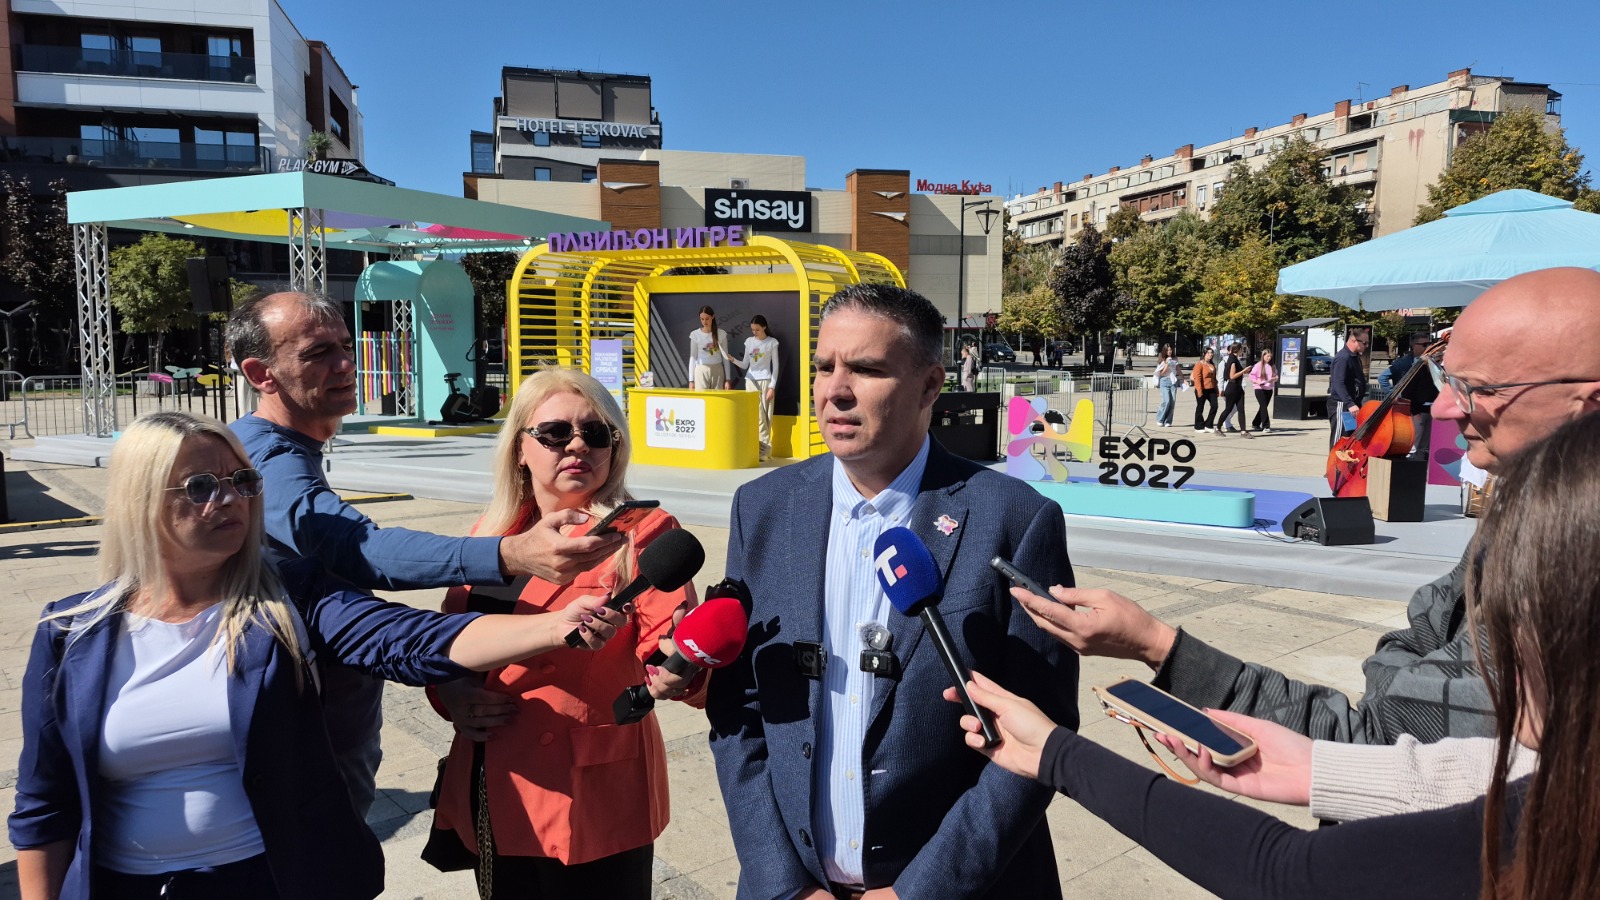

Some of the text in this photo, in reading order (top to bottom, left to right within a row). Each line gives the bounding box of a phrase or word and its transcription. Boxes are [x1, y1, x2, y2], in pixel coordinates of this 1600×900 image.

[516, 118, 647, 138] HOTEL LESKOVAC
[917, 179, 991, 195] Модна Кућа
[714, 192, 804, 228] sinsay
[548, 225, 744, 252] ПАВИЉОН ИГРЕ
[1099, 436, 1197, 463] EXPO
[1098, 461, 1195, 489] 2027
